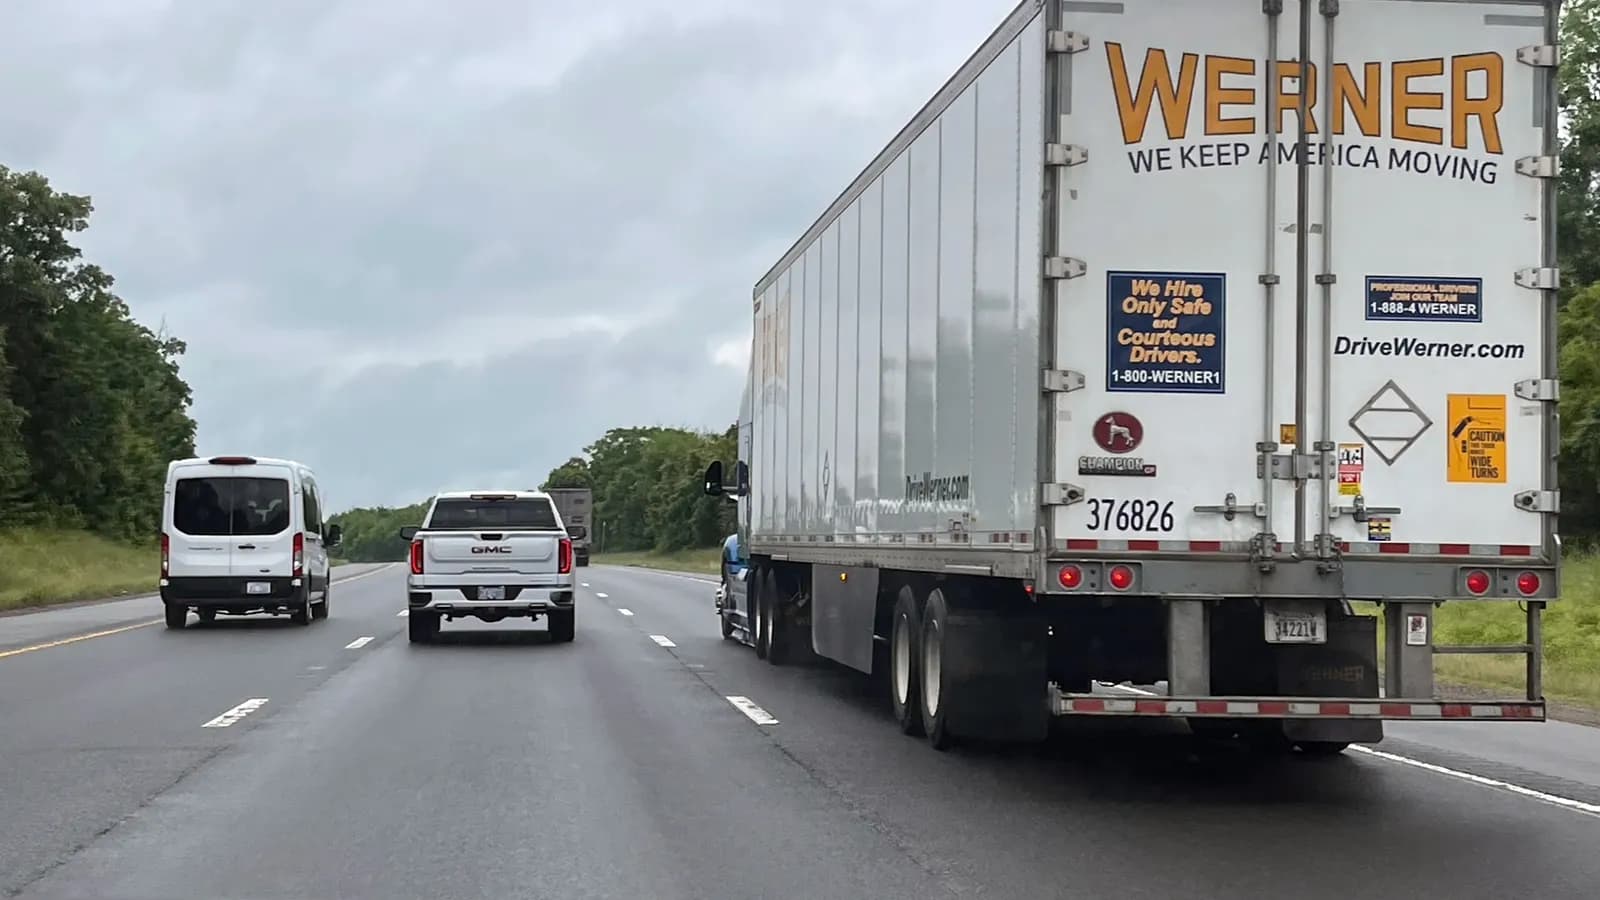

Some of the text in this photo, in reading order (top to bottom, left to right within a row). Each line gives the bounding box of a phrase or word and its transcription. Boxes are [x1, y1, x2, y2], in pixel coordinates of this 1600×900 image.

[1104, 41, 1504, 155] WERNER
[1128, 142, 1498, 185] WE KEEP AMERICA MOVING
[1131, 279, 1203, 298] We Hire
[1122, 297, 1212, 318] Only Safe
[1418, 303, 1477, 315] WERNER
[1152, 317, 1178, 329] and
[1117, 328, 1216, 347] Courteous
[1129, 346, 1202, 363] Drivers.
[1334, 336, 1525, 359] DriveWerner.com
[1112, 369, 1220, 384] 1-800-WERNER1
[1470, 431, 1505, 442] CAUTION
[1471, 456, 1493, 467] WIDE
[1472, 467, 1499, 478] TURNS
[1086, 498, 1174, 532] 376826
[471, 546, 512, 554] GMC
